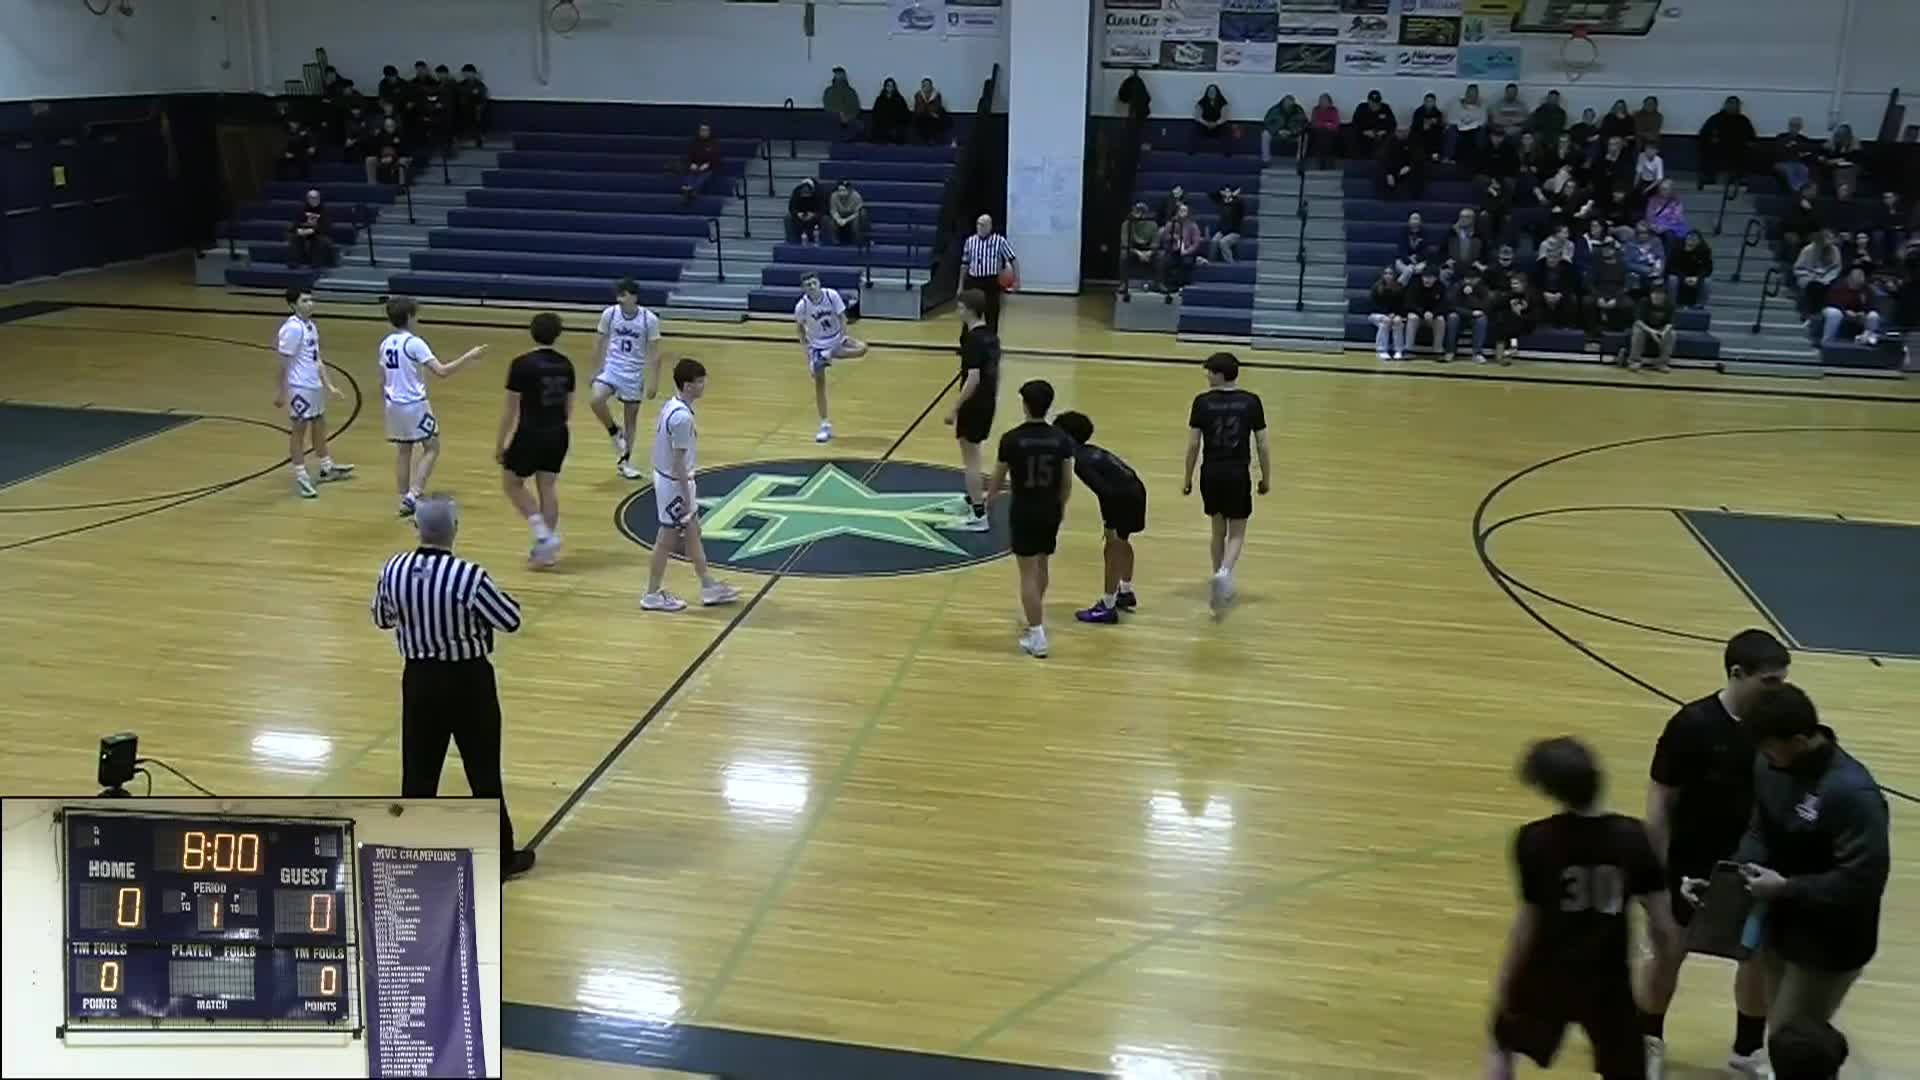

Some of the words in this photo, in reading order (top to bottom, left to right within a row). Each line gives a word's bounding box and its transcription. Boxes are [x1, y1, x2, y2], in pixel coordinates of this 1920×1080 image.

[385, 349, 400, 369] 31
[1023, 455, 1054, 488] 15
[183, 831, 259, 872] 8:00
[375, 848, 397, 860] MVC
[400, 849, 457, 861] CHAMPIONS
[88, 859, 136, 879] HOME
[280, 867, 328, 886] GUEST
[193, 882, 227, 894] PERIOD
[1560, 864, 1624, 915] 30
[117, 887, 141, 927] 0
[213, 901, 219, 928] 1
[310, 893, 331, 932] 0
[72, 942, 90, 955] TM
[93, 942, 128, 956] FOULS
[171, 944, 212, 957] PLAYER
[224, 946, 256, 958] FOULS
[294, 948, 309, 959] TM
[313, 948, 345, 960] FOULS
[101, 961, 119, 992] 0
[320, 965, 337, 995] 0
[82, 998, 118, 1010] POINTS
[197, 1000, 228, 1011] MATCH
[304, 1001, 337, 1013] POINTS
